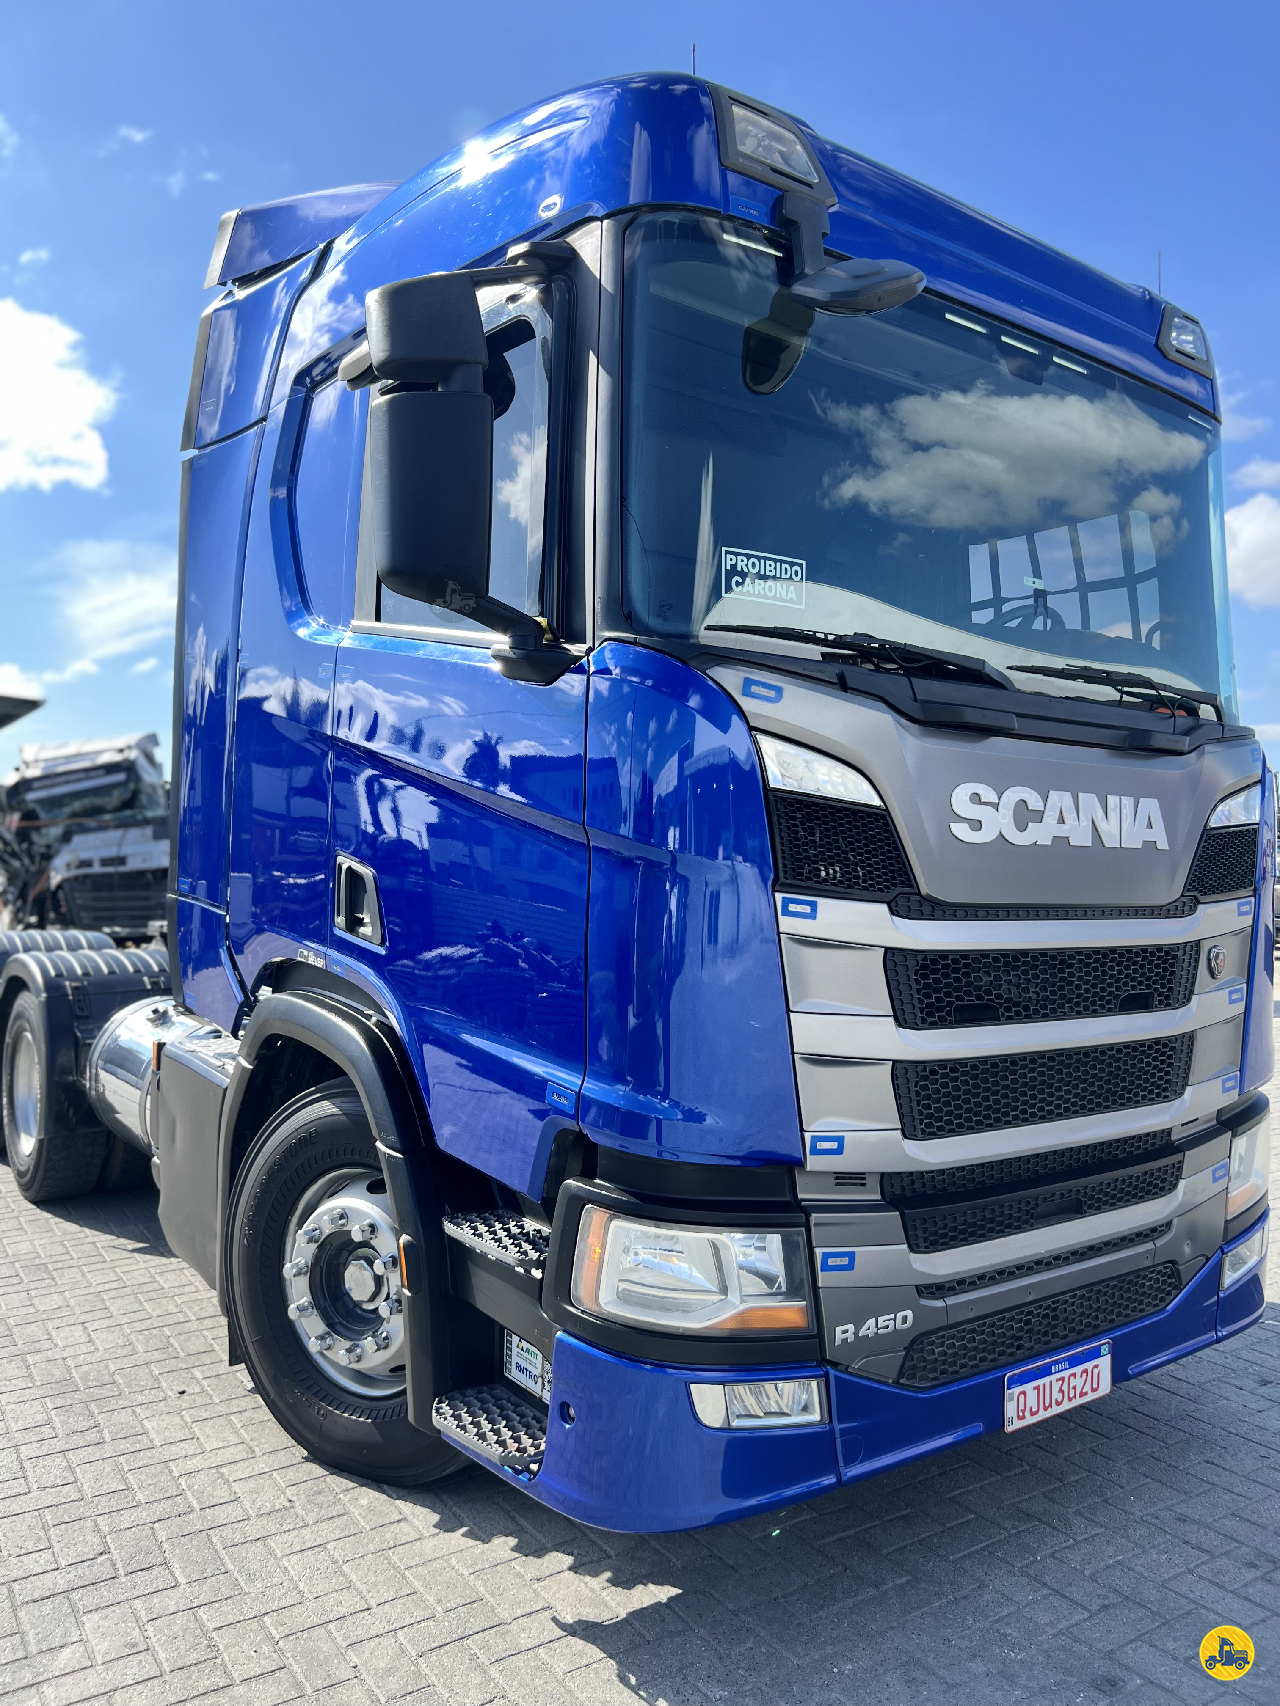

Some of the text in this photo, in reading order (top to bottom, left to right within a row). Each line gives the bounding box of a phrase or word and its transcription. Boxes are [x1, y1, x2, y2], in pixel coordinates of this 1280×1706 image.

[726, 553, 802, 582] PROIBIDO
[731, 575, 797, 601] CARONA
[949, 782, 1169, 850] SCANIA
[834, 1309, 914, 1346] R 450
[1051, 1360, 1070, 1374] BRASIL
[1015, 1363, 1100, 1422] QJU3G20
